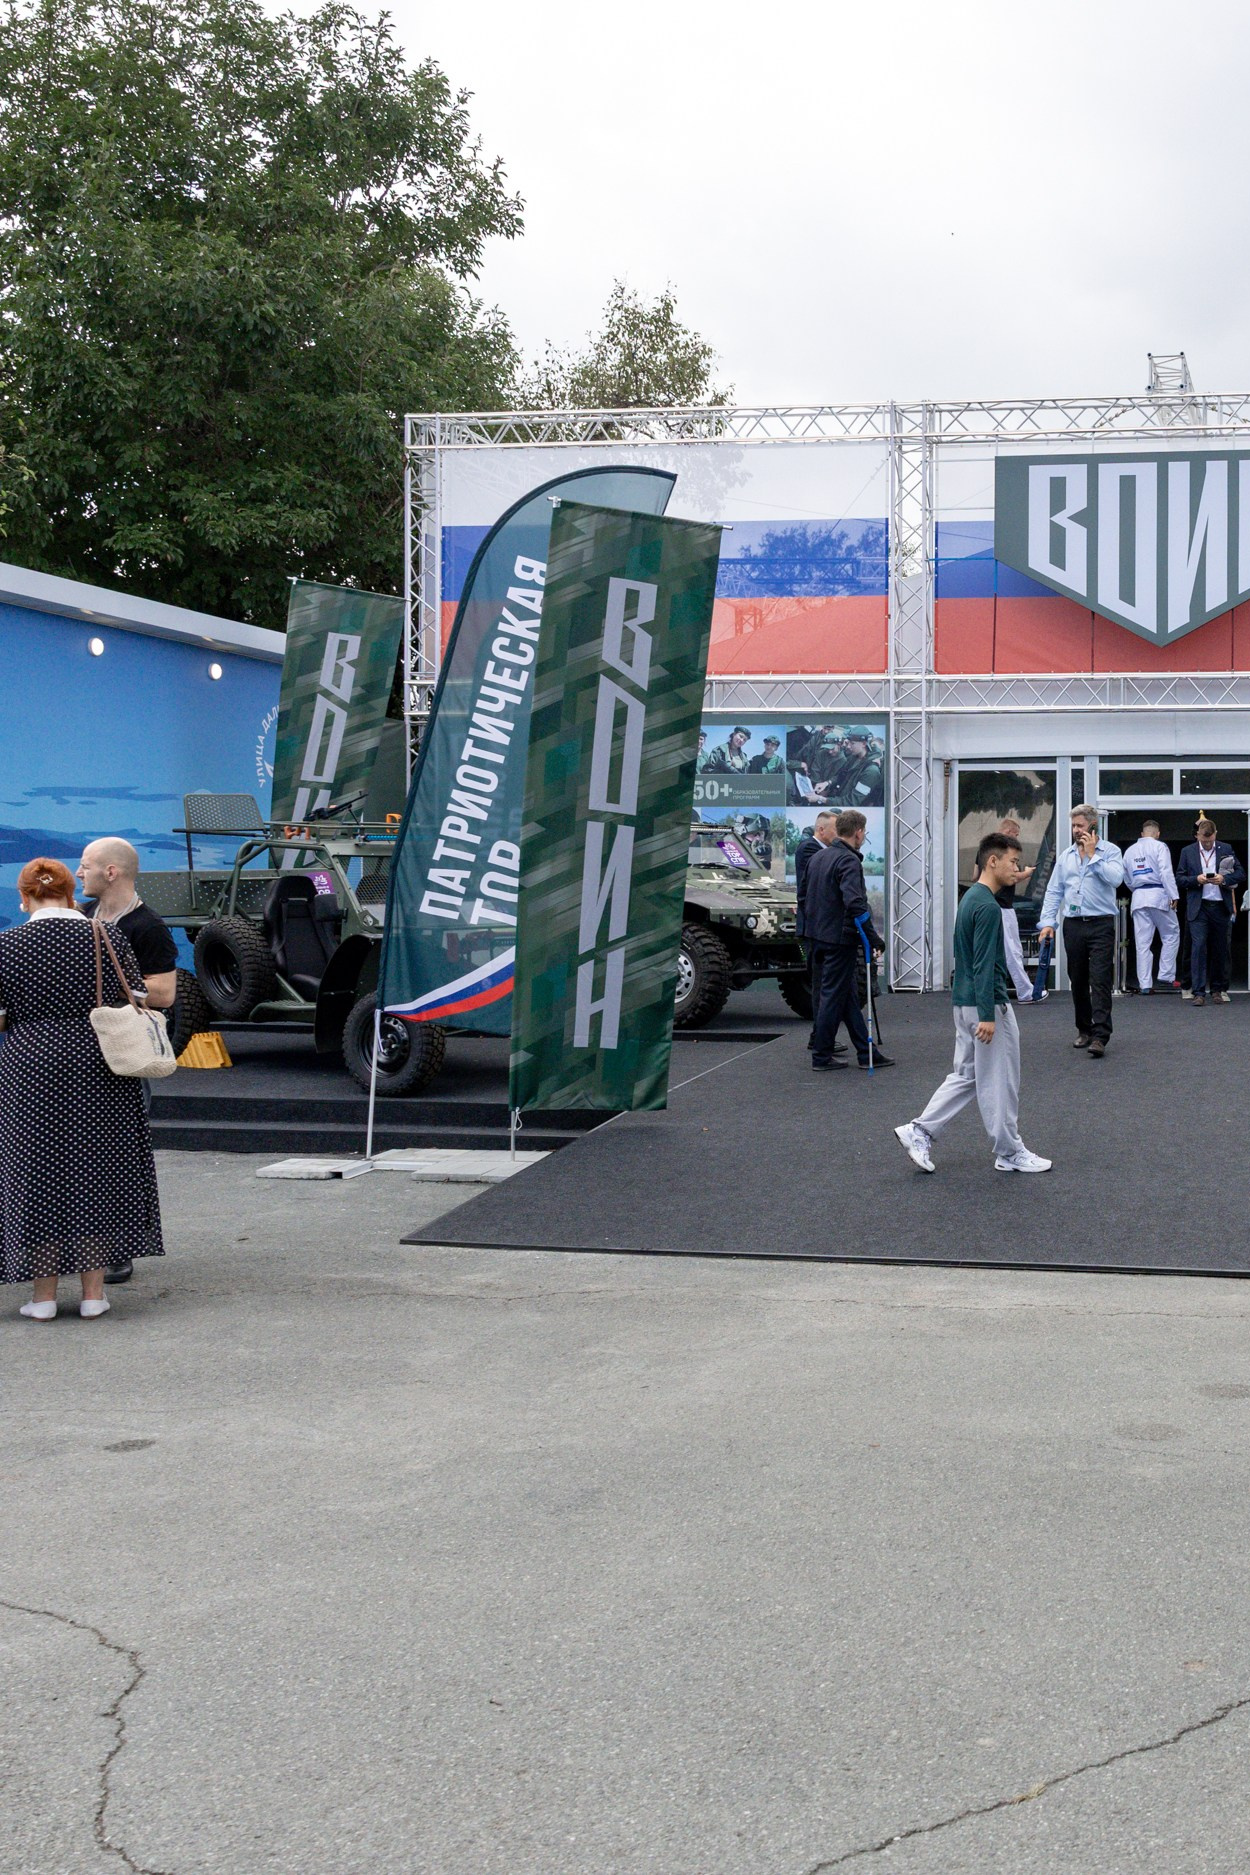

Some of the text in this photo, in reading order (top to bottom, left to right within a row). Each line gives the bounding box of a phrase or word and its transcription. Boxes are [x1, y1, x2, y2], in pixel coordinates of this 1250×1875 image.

[256, 735, 267, 788] УЛИЦА
[281, 632, 362, 869] ВОИ
[419, 555, 547, 920] ПАТРИОТИЧЕСКАЯ
[573, 577, 658, 1049] ВОИН
[693, 780, 733, 800] 50+
